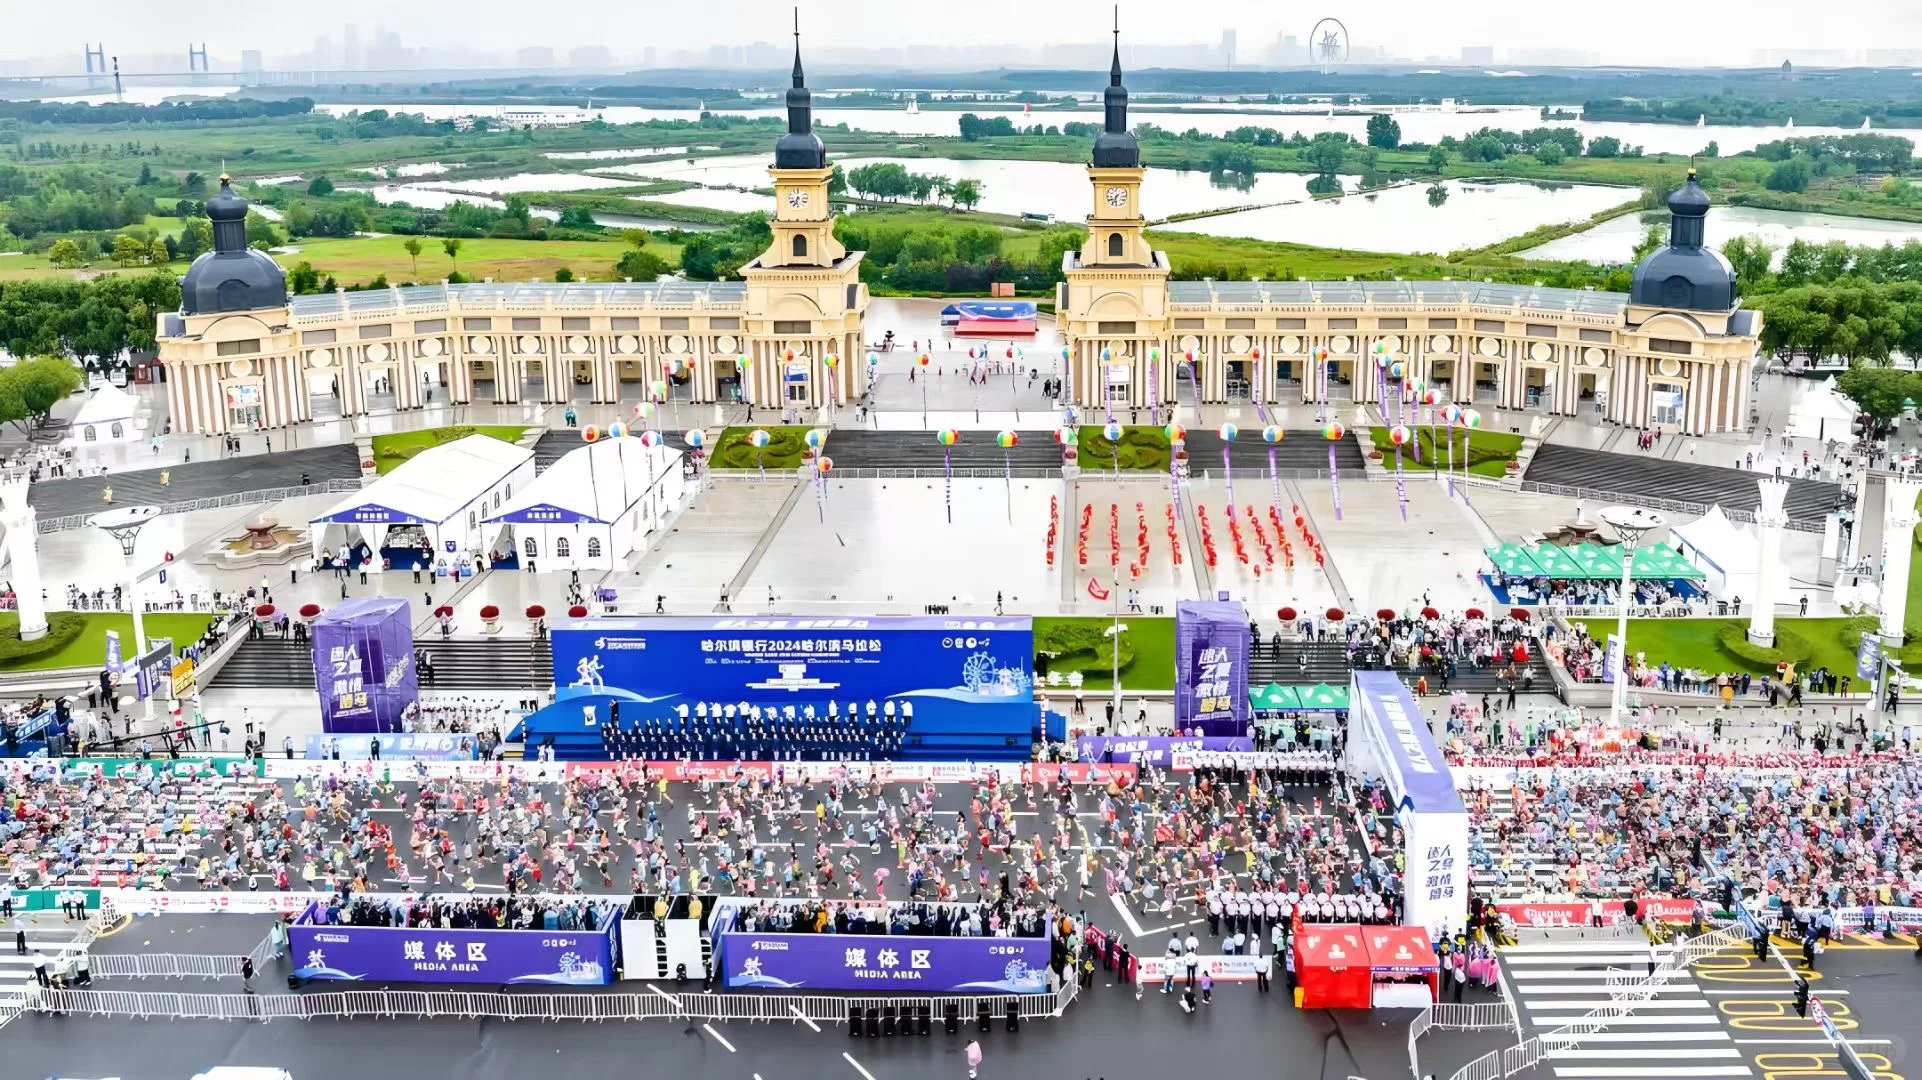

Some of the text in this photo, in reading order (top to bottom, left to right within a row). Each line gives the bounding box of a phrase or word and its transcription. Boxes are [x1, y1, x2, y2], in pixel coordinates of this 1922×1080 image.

[701, 639, 882, 652] 哈尔滨银行2024哈尔滨马拉松
[404, 940, 488, 961] 媒体区
[845, 947, 931, 968] 媒体区
[414, 962, 479, 972] MEDIA AREA
[854, 969, 922, 980] MEDIA AREA
